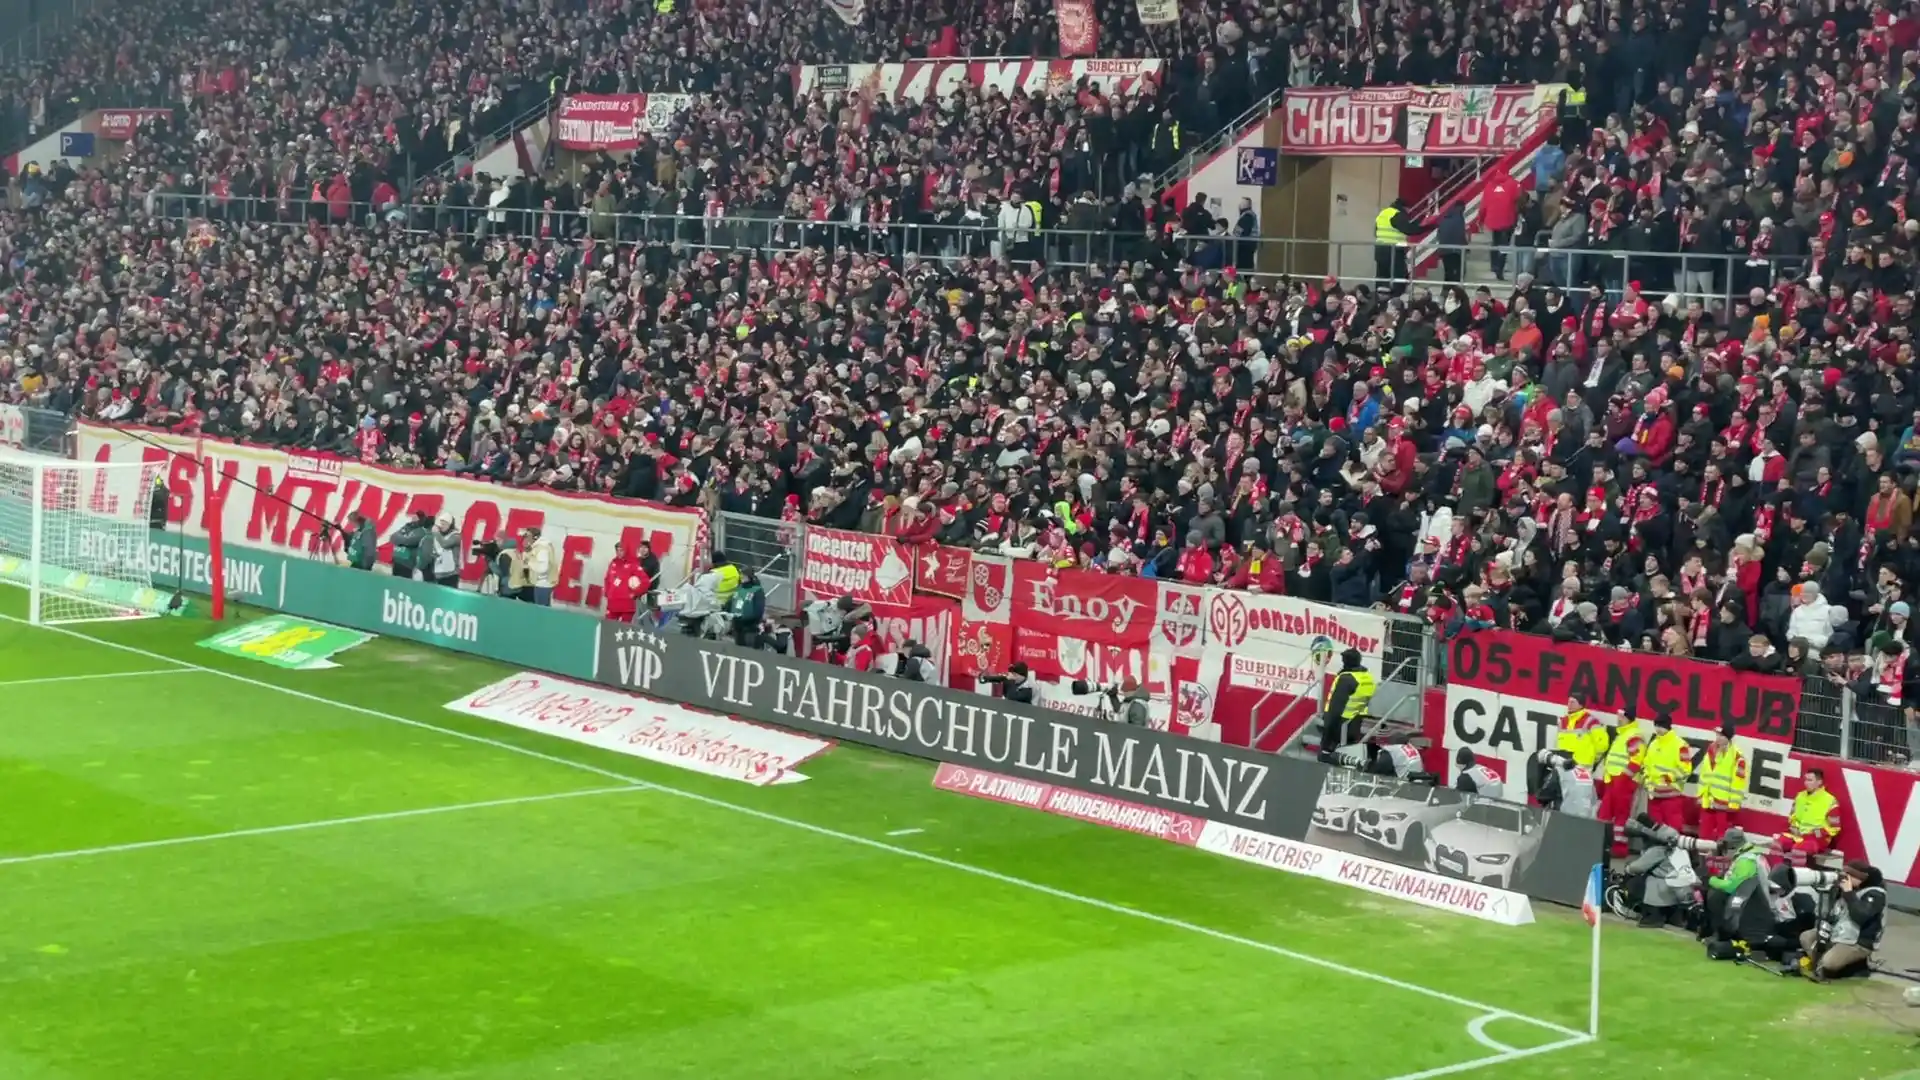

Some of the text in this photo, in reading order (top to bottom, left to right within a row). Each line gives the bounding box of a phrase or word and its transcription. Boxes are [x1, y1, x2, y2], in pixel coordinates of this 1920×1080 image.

[1286, 97, 1394, 145] CHAOS
[382, 589, 479, 642] bito.com
[617, 645, 664, 690] VIP
[1452, 636, 1796, 738] 05-FANCLUB
[699, 650, 1270, 821] VIP FAHRSCHULE MAINZ
[968, 773, 1043, 805] PLATINUM
[1049, 790, 1172, 836] HUNDENAHRUNG
[1229, 833, 1489, 912] MEATCRISP KATZENNAHRUNG
